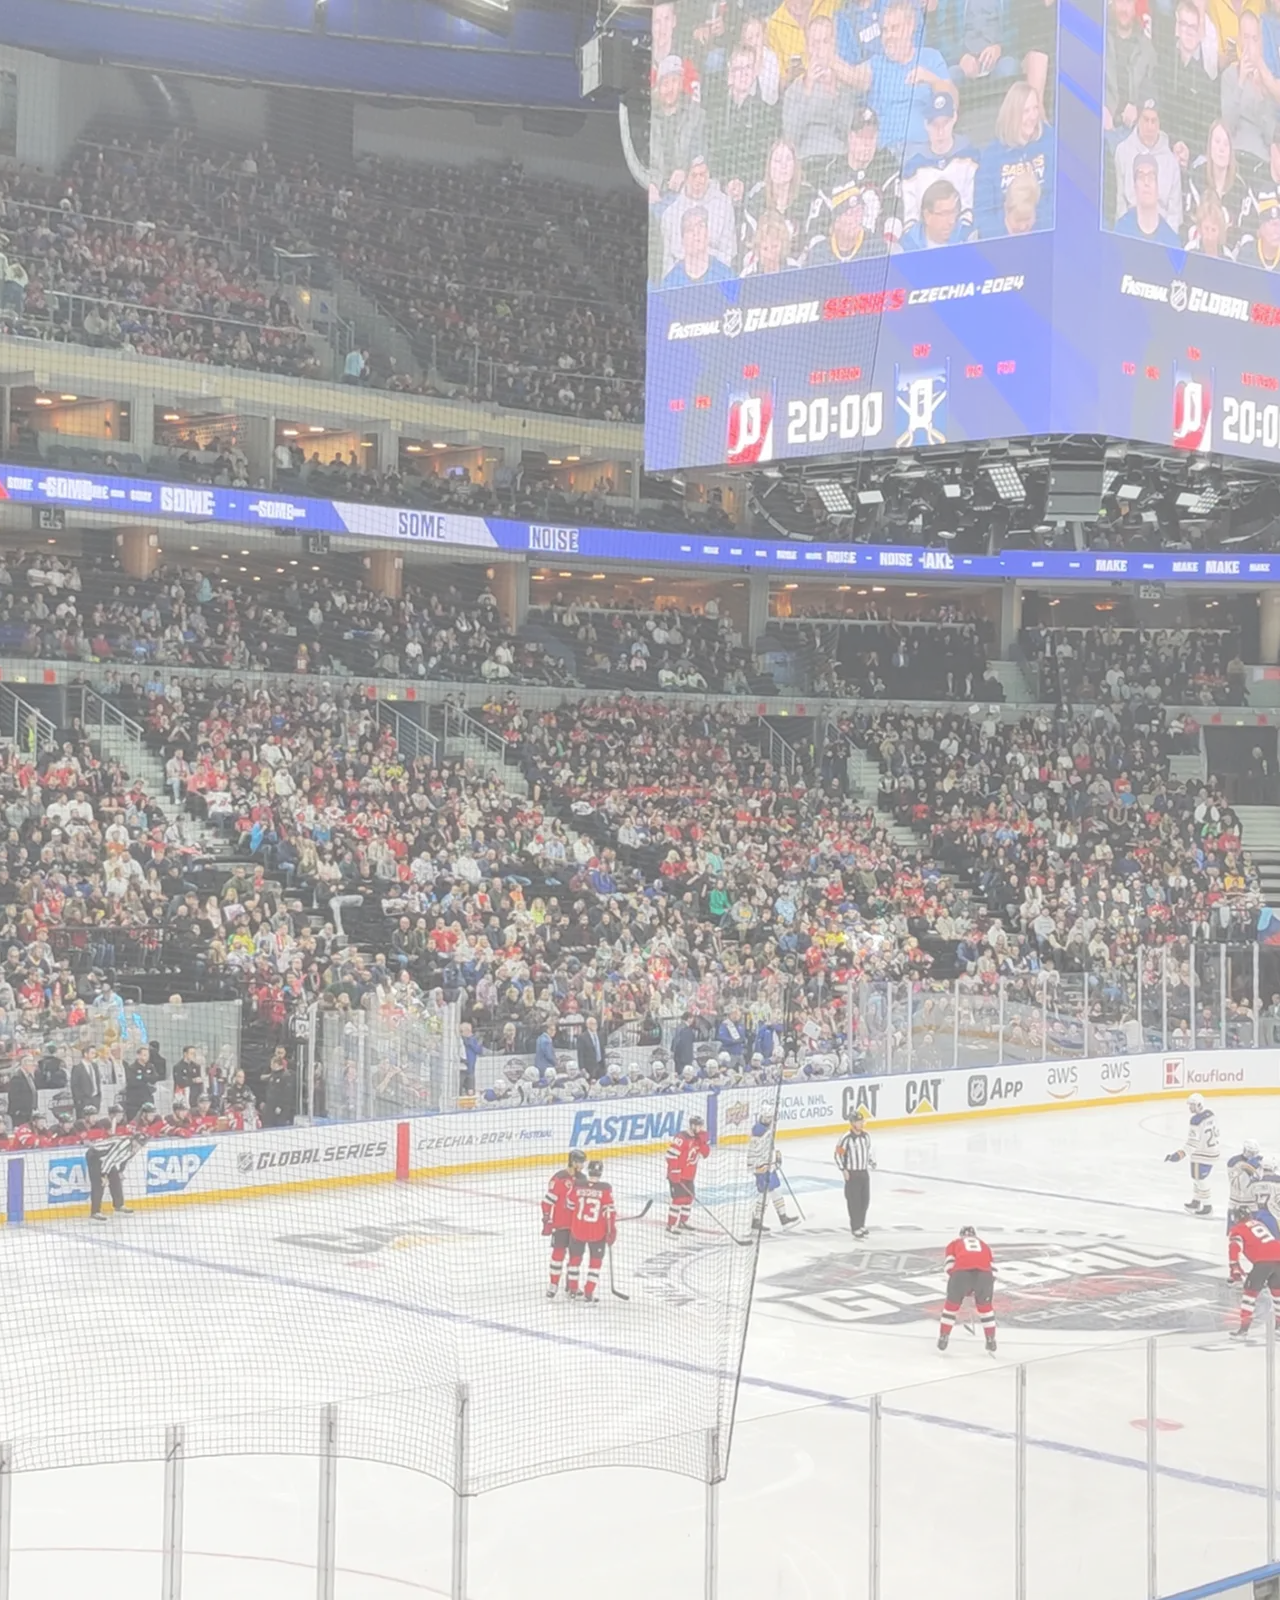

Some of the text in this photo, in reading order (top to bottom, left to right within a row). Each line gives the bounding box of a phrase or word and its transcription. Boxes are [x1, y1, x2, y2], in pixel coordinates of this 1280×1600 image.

[744, 301, 820, 333] GLOBAL
[1188, 287, 1249, 322] GLOBAL
[787, 391, 883, 444] 20:00
[398, 511, 446, 540] SOME
[529, 525, 579, 553] NOISE
[922, 551, 954, 569] AKE
[1095, 558, 1127, 572] MAKE
[1205, 560, 1240, 575] MAKE
[1047, 1066, 1078, 1085] aws
[1101, 1062, 1131, 1080] aws
[1187, 1068, 1244, 1084] Kaufland
[761, 1093, 827, 1108] OFICIAL NHL
[842, 1083, 880, 1121] CAT
[905, 1079, 942, 1114] CAT
[752, 1109, 797, 1122] TDING
[799, 1105, 834, 1119] CARDS
[418, 1135, 473, 1151] CZECHIA
[479, 1130, 513, 1145] 2024
[257, 1141, 388, 1171] GLOBAL SERIES
[49, 1165, 89, 1197] SA
[147, 1153, 200, 1187] SAP
[577, 1196, 601, 1222] 13
[963, 1236, 982, 1252] 8
